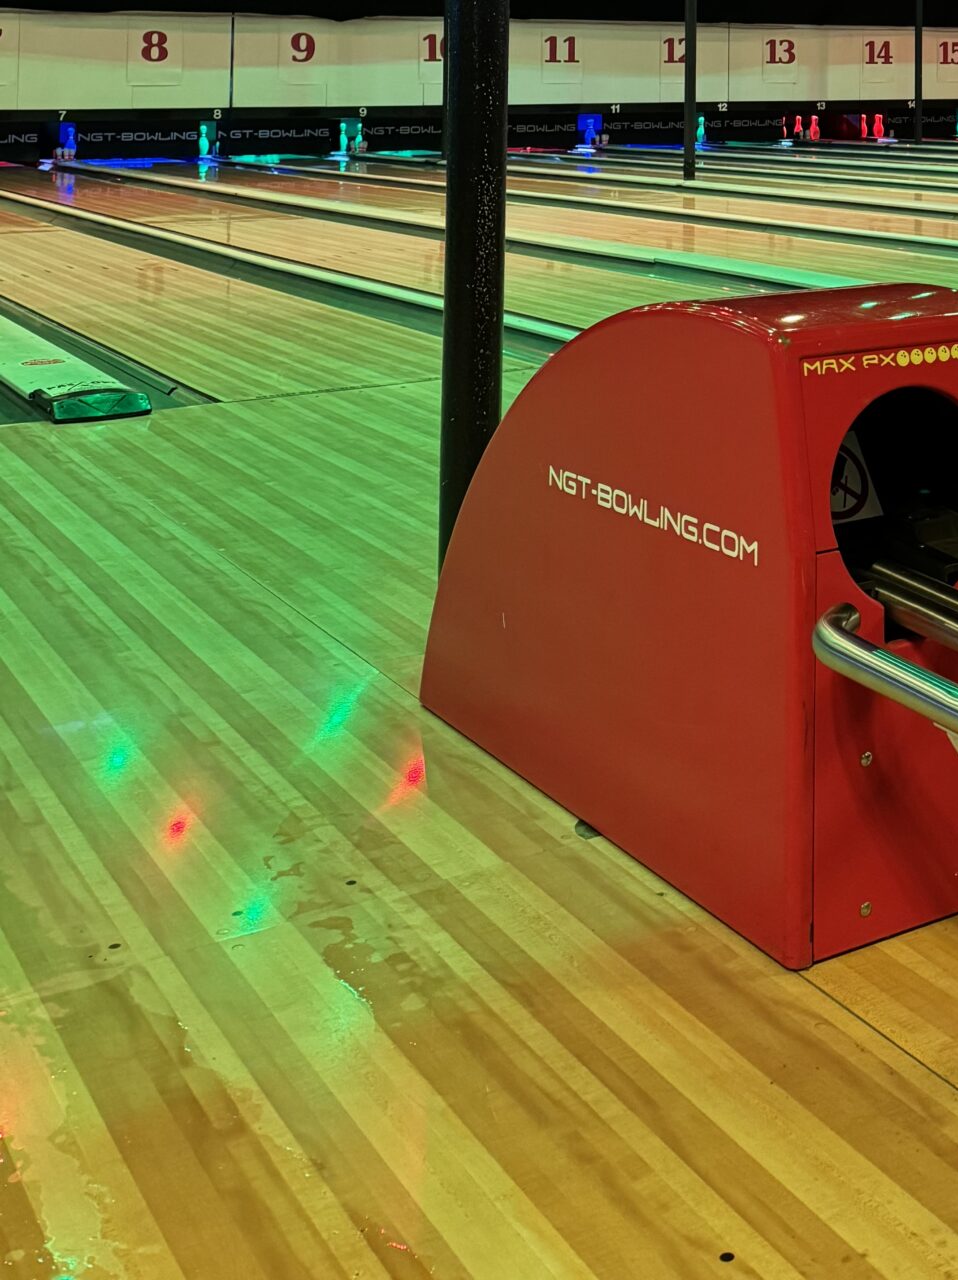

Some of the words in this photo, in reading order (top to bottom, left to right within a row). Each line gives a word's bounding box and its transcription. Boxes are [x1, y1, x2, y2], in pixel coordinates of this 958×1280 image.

[140, 30, 169, 63] 8
[289, 32, 316, 63] 9
[421, 33, 445, 62] 1
[543, 36, 581, 64] 11
[662, 37, 686, 64] 12
[764, 38, 796, 65] 13
[864, 40, 894, 65] 14
[213, 109, 222, 120] 8
[359, 107, 367, 117] 9
[610, 104, 621, 113] 11
[717, 103, 728, 111] 12
[816, 102, 826, 110] 13
[907, 100, 916, 109] 14
[58, 110, 67, 121] 7
[77, 131, 198, 142] NGT-BOWLING
[803, 356, 856, 376] MAX
[548, 465, 758, 567] NGT-BOWLING.COM
